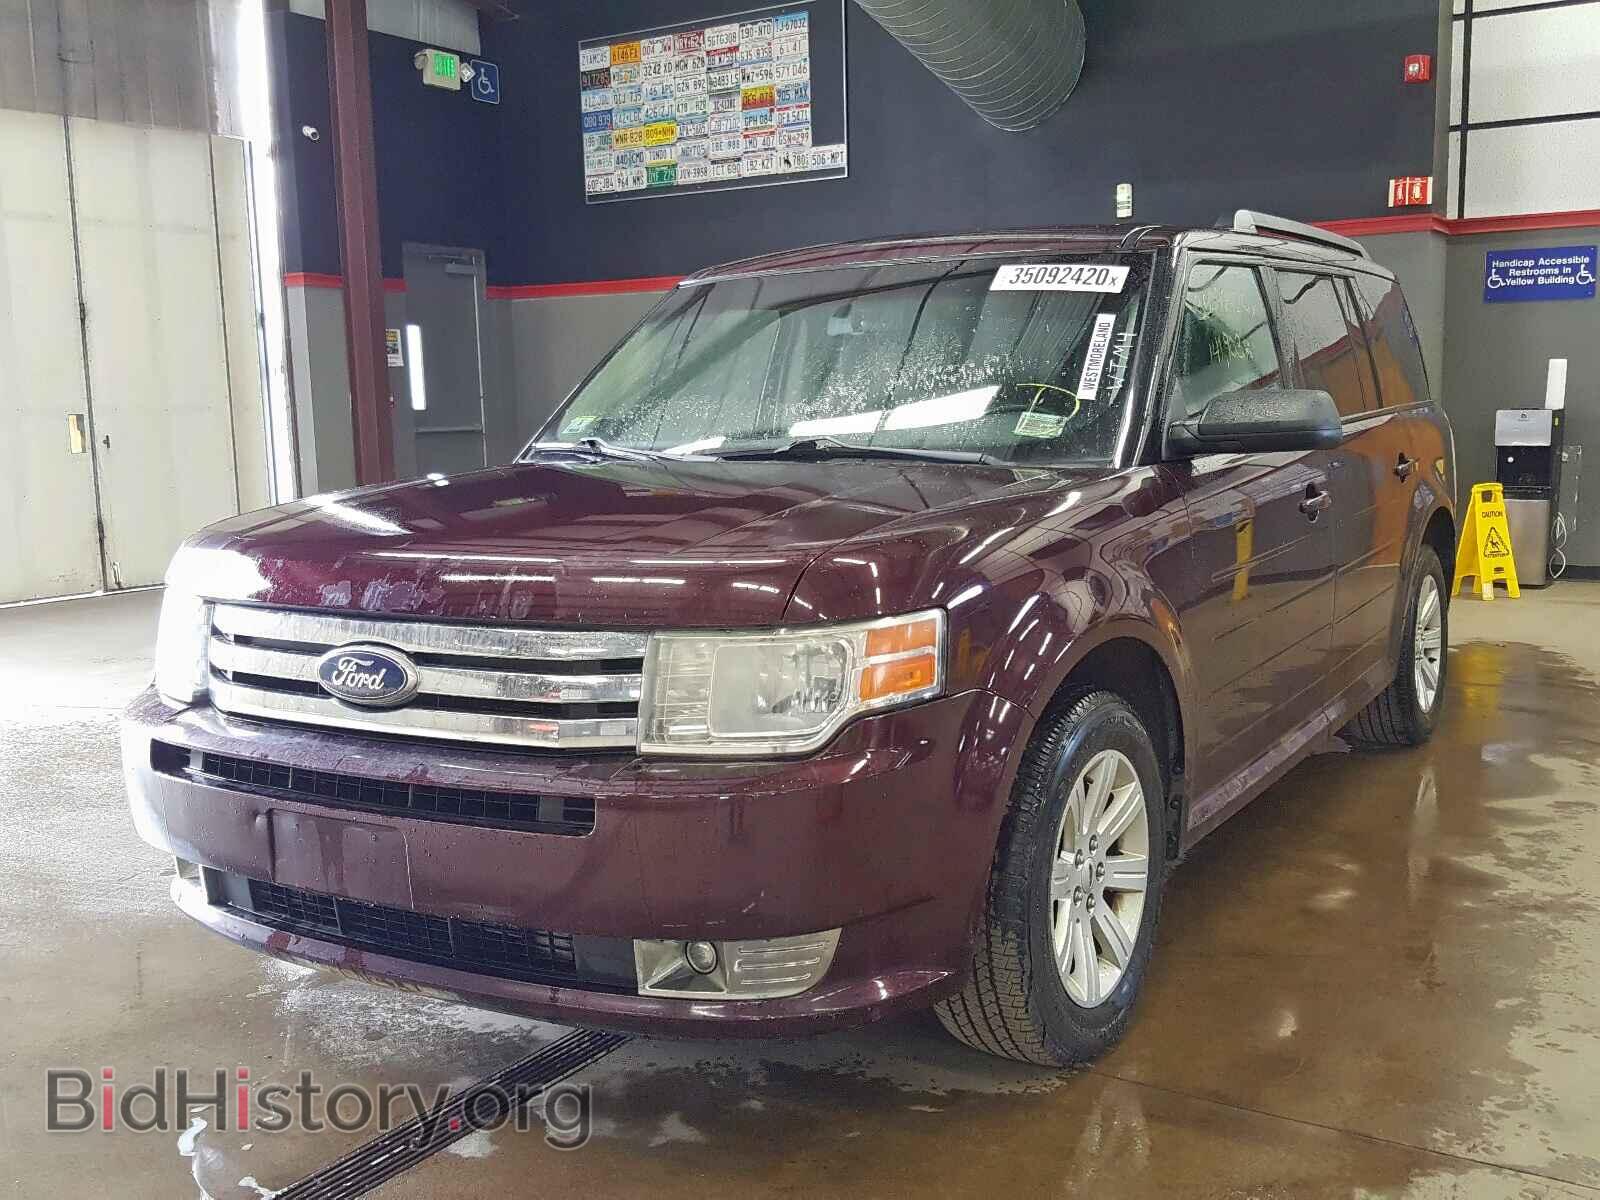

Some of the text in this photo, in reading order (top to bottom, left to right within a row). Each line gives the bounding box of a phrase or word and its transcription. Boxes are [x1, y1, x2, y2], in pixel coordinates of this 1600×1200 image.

[1492, 256, 1590, 268] Handicap Accessible
[1509, 267, 1559, 276] Restrooms
[1506, 276, 1575, 286] Yellow Building
[1082, 322, 1111, 391] WESTMORELAND
[1482, 510, 1503, 518] CAUTION
[332, 656, 387, 690] Ford
